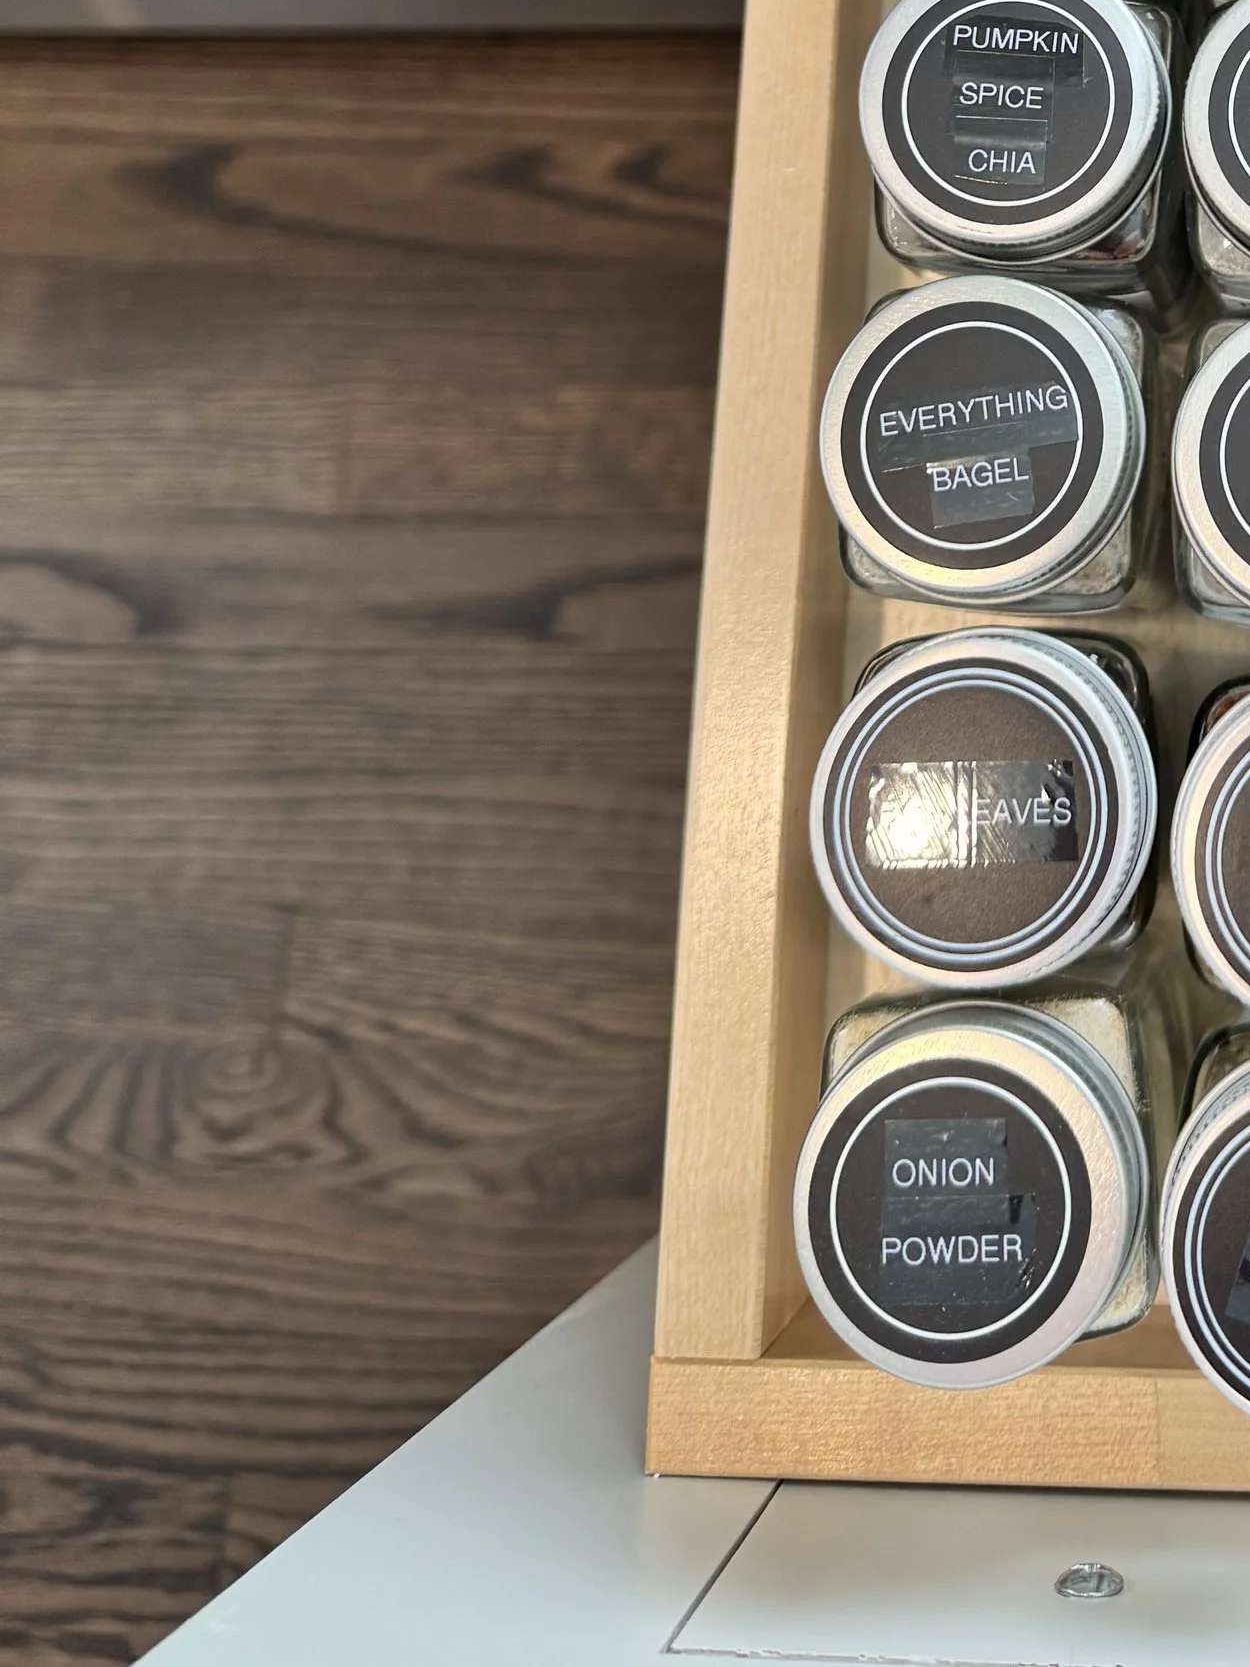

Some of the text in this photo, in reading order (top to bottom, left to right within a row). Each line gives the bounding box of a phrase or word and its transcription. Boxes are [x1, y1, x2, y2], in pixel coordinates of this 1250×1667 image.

[951, 24, 1081, 55] PUMPKIN
[958, 81, 1045, 111] SPICE
[966, 147, 1038, 176] CHIA
[879, 385, 1071, 438] EVERYTHING
[930, 457, 1031, 489] BAGEL
[958, 796, 1073, 828] EAVES
[890, 1157, 996, 1188] ONION
[881, 1234, 1024, 1266] POWDER
